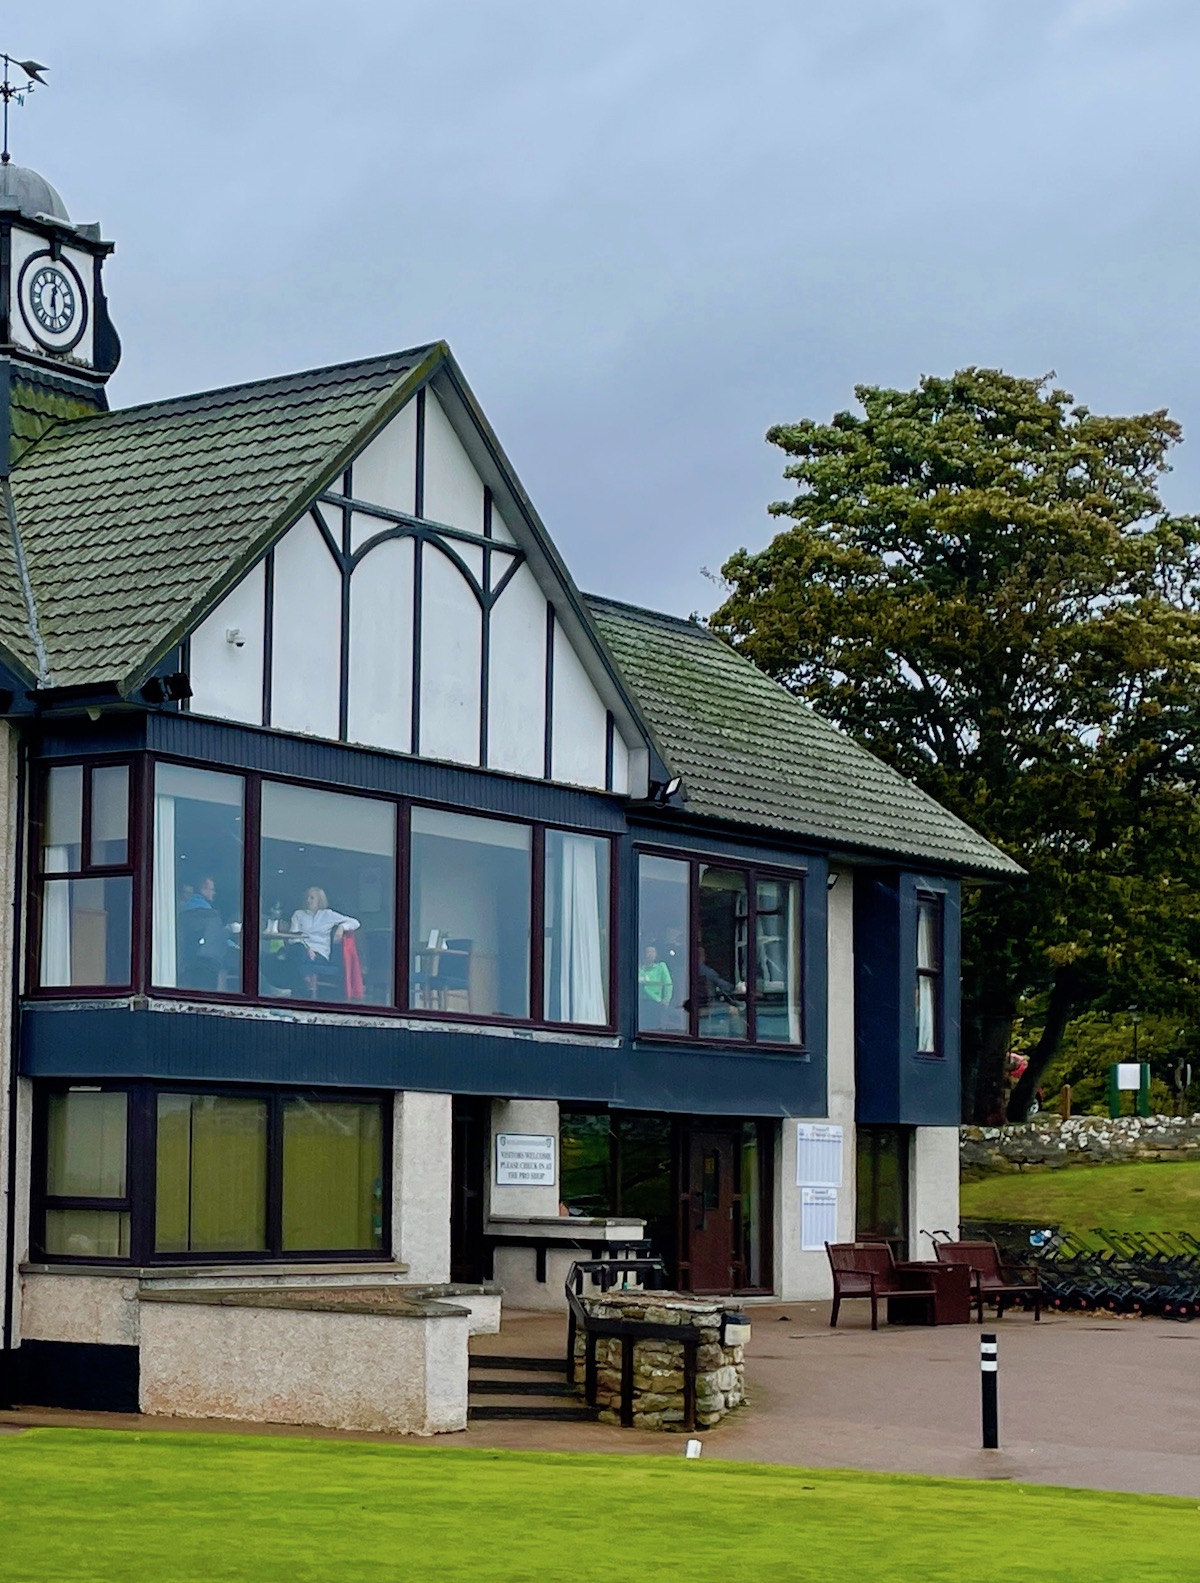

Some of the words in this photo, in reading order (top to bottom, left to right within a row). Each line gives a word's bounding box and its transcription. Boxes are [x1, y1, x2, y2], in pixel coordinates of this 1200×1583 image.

[27, 80, 35, 93] E
[501, 1151, 524, 1159] VISITORS
[525, 1152, 552, 1160] WELCOME
[500, 1161, 519, 1169] PLEASE
[531, 1172, 545, 1180] SHOP
